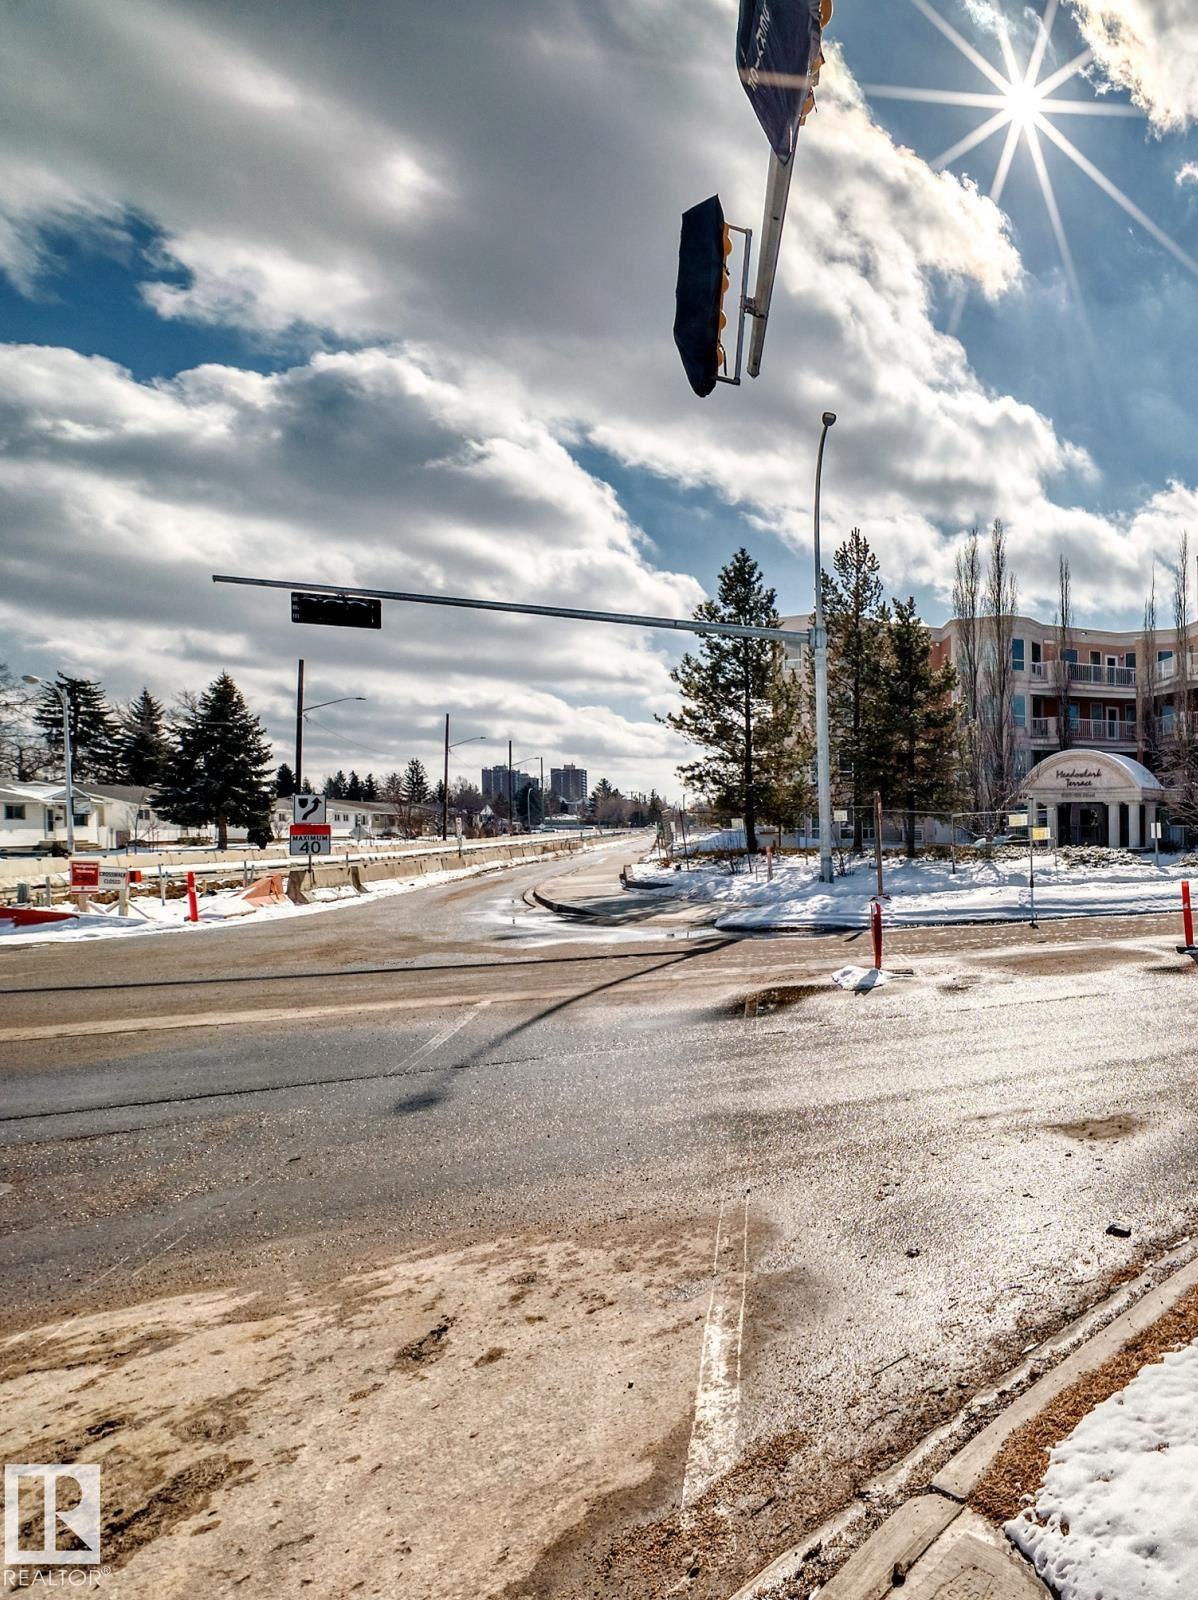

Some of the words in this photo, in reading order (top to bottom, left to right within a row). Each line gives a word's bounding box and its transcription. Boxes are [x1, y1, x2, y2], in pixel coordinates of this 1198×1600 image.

[1056, 768, 1102, 779] Meadowlark
[1065, 778, 1093, 788] Terrace
[299, 841, 321, 854] 40
